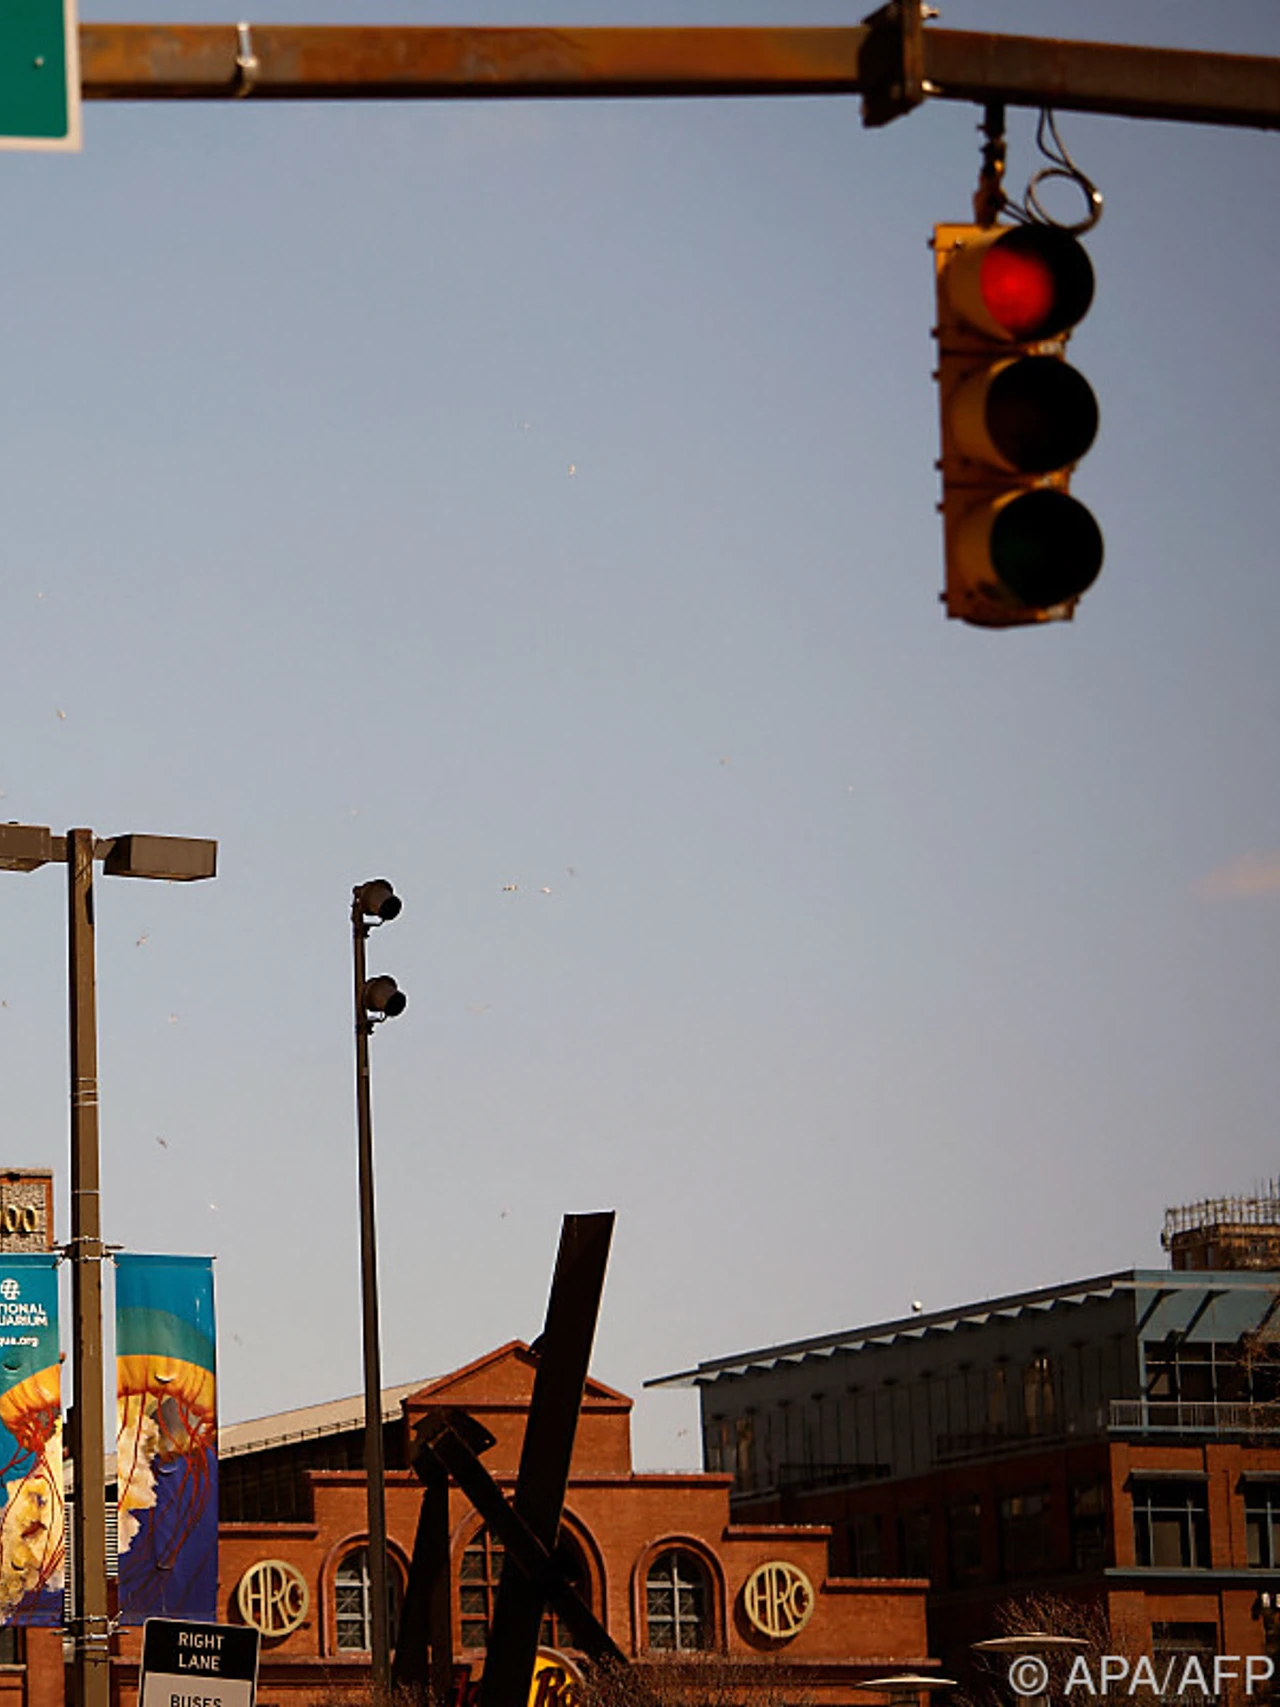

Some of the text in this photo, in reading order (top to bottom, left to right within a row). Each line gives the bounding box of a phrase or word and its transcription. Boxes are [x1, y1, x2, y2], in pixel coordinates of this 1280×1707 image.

[178, 1632, 225, 1650] RIGHT
[178, 1653, 221, 1672] LANE
[170, 1693, 223, 1707] BUSES
